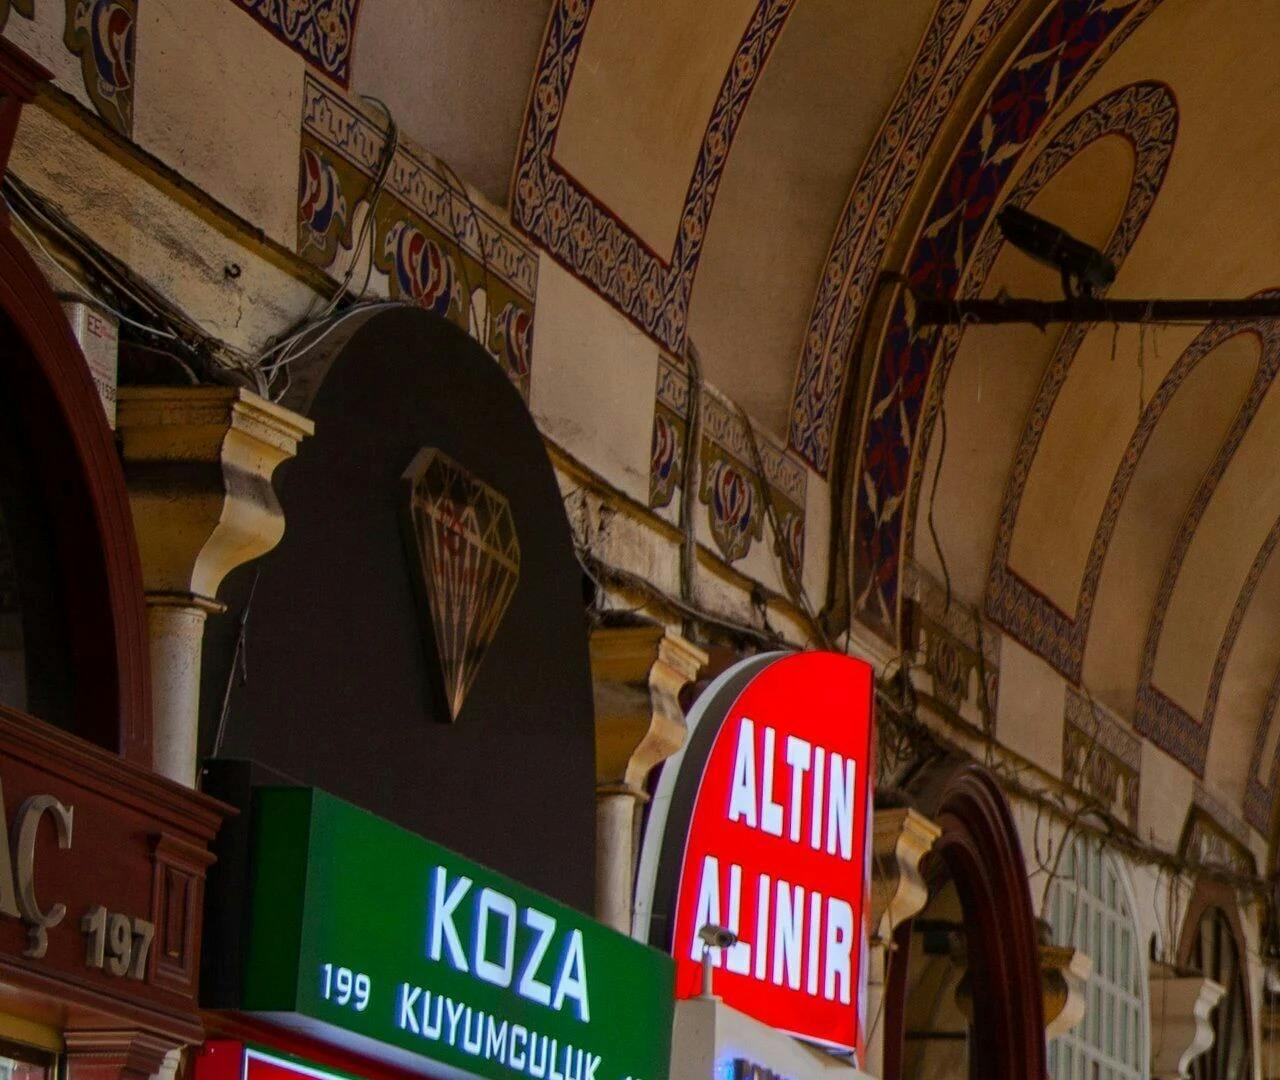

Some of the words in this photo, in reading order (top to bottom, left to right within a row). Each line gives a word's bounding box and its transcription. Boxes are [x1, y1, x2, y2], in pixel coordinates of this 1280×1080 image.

[728, 717, 857, 861] ALTIN
[81, 904, 155, 981] 197
[320, 961, 371, 1013] 199
[427, 865, 592, 1023] KOZA
[690, 855, 855, 1005] ALINIR
